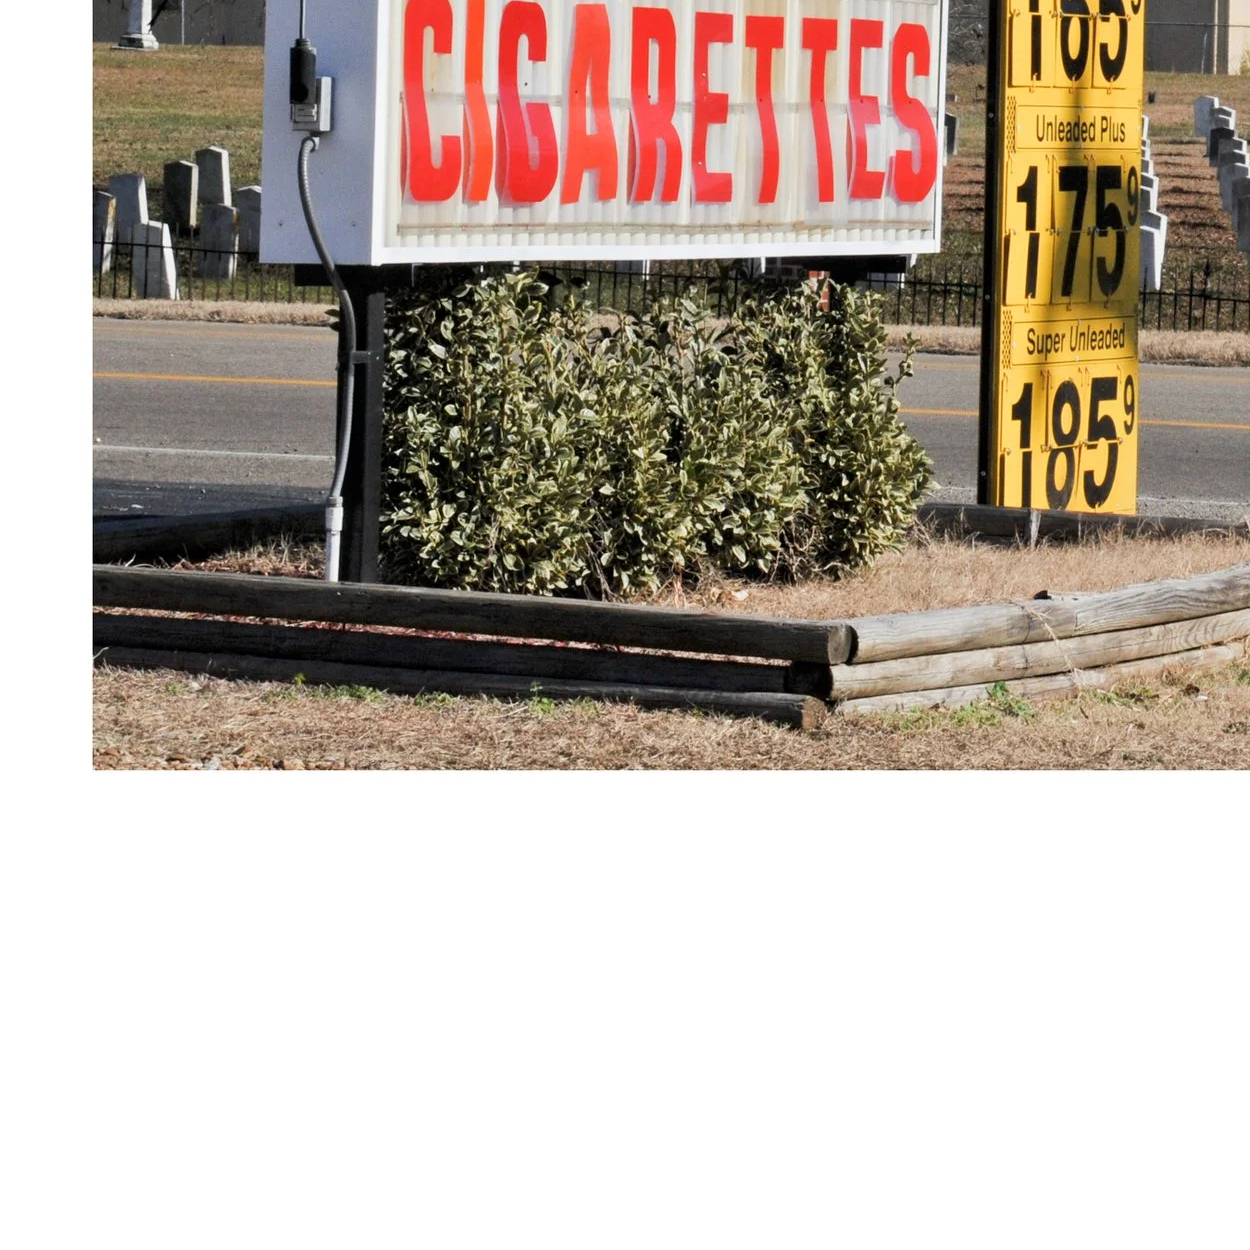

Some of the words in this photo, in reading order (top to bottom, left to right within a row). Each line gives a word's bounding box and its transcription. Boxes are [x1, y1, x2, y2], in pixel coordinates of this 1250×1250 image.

[1036, 114, 1096, 143] Unleaded
[1100, 115, 1126, 143] Plus
[1026, 327, 1066, 362] Super
[1069, 322, 1126, 352] Unleaded
